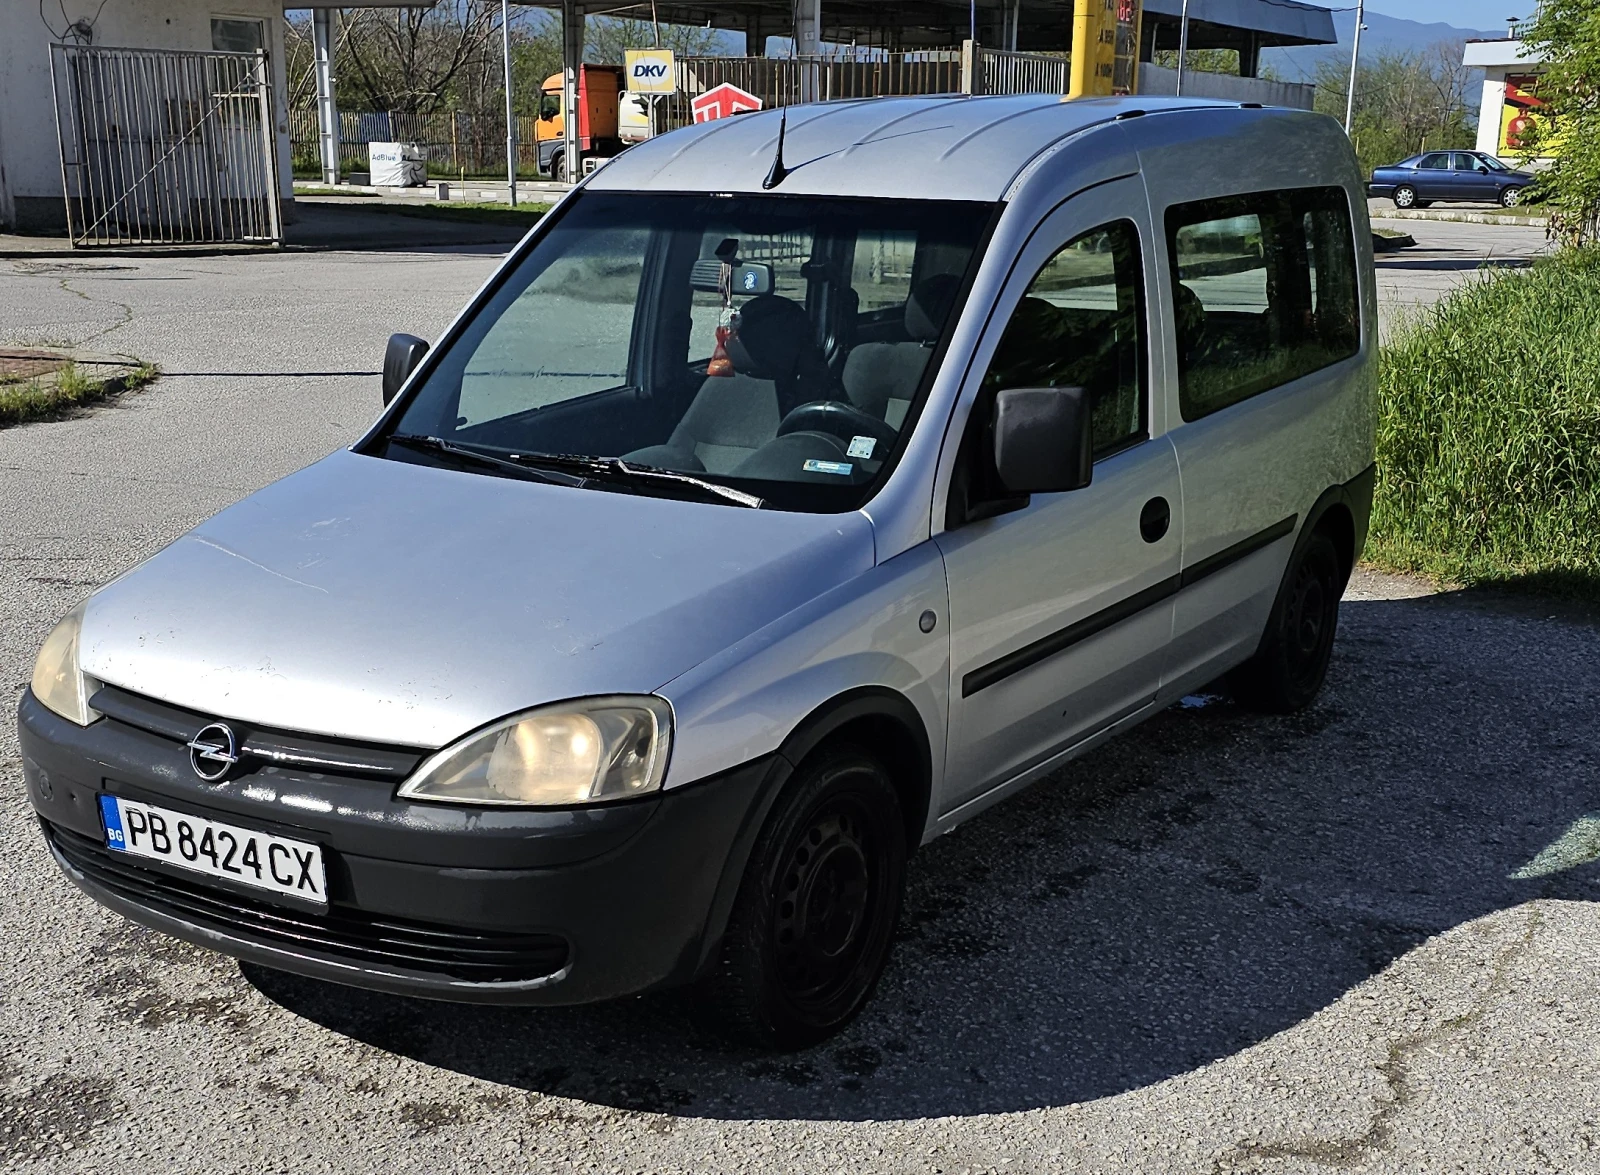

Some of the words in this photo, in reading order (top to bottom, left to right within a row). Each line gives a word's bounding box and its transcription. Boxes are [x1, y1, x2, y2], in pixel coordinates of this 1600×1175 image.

[633, 65, 668, 78] DKV
[107, 828, 123, 843] BG
[125, 806, 171, 854] PB
[177, 820, 263, 880] 8424
[268, 842, 319, 894] CX
